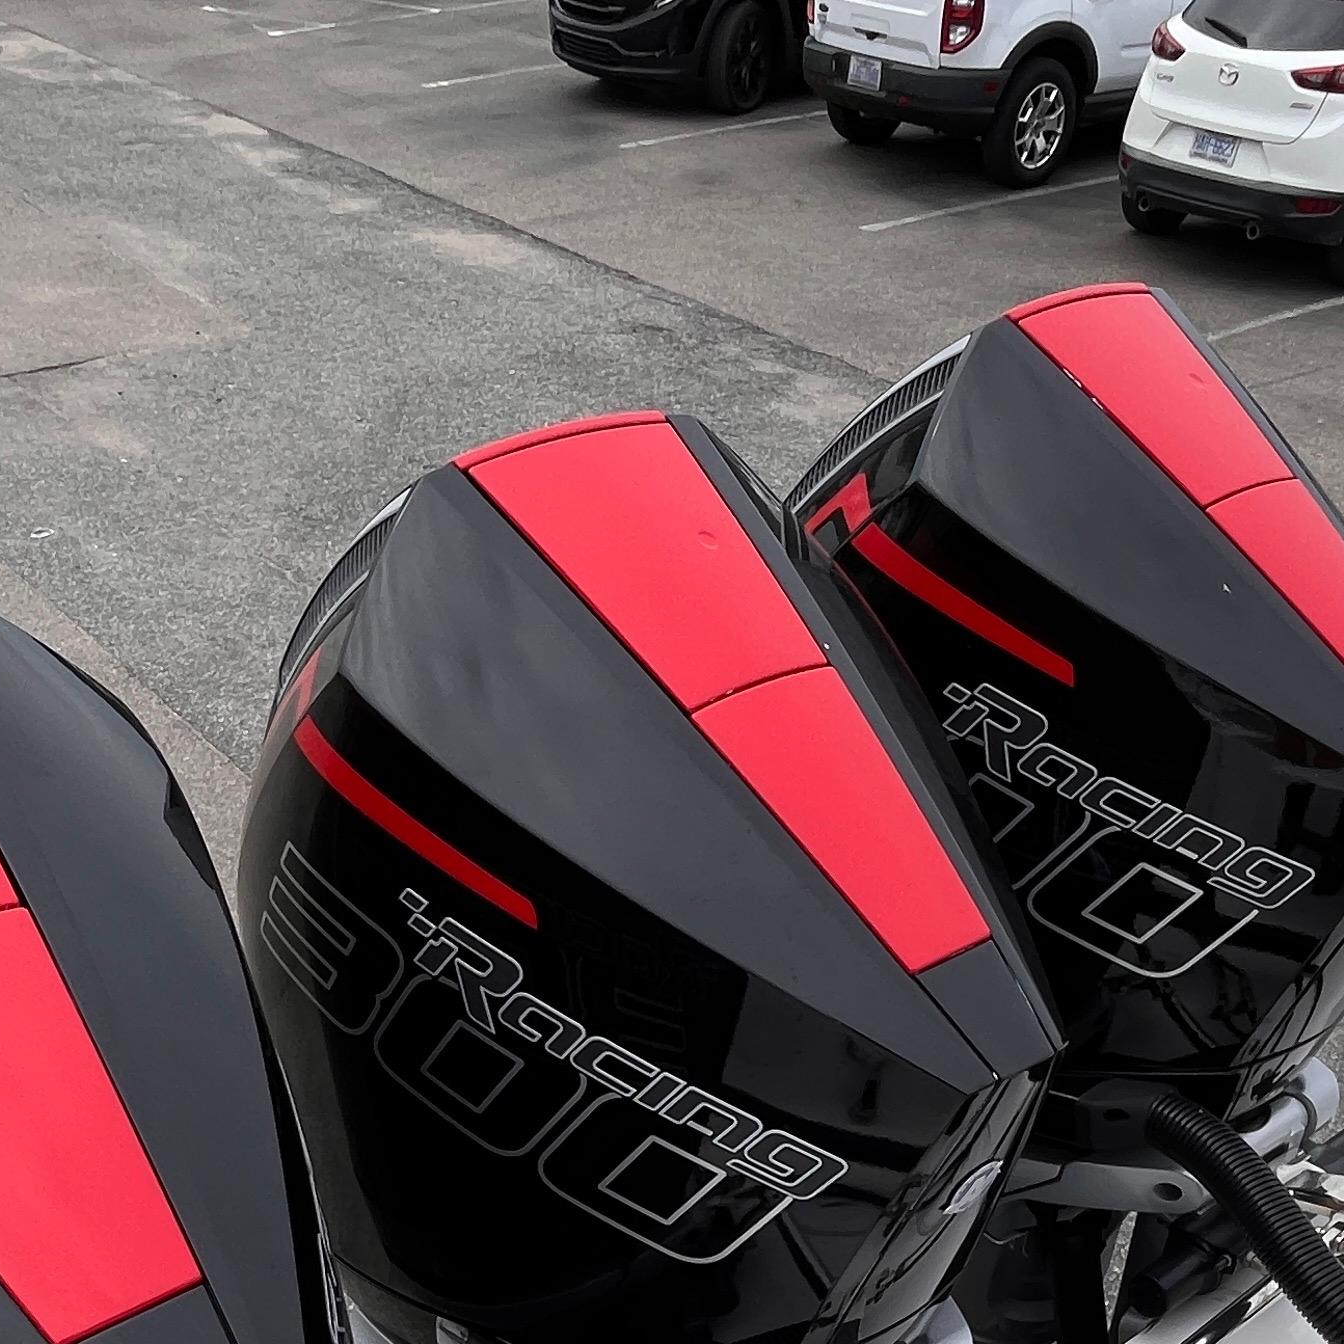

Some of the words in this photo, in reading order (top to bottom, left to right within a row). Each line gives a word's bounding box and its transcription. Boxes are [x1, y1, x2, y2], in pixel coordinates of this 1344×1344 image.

[942, 682, 1316, 909] Racing
[260, 840, 793, 1264] 300
[413, 916, 849, 1201] Racing
